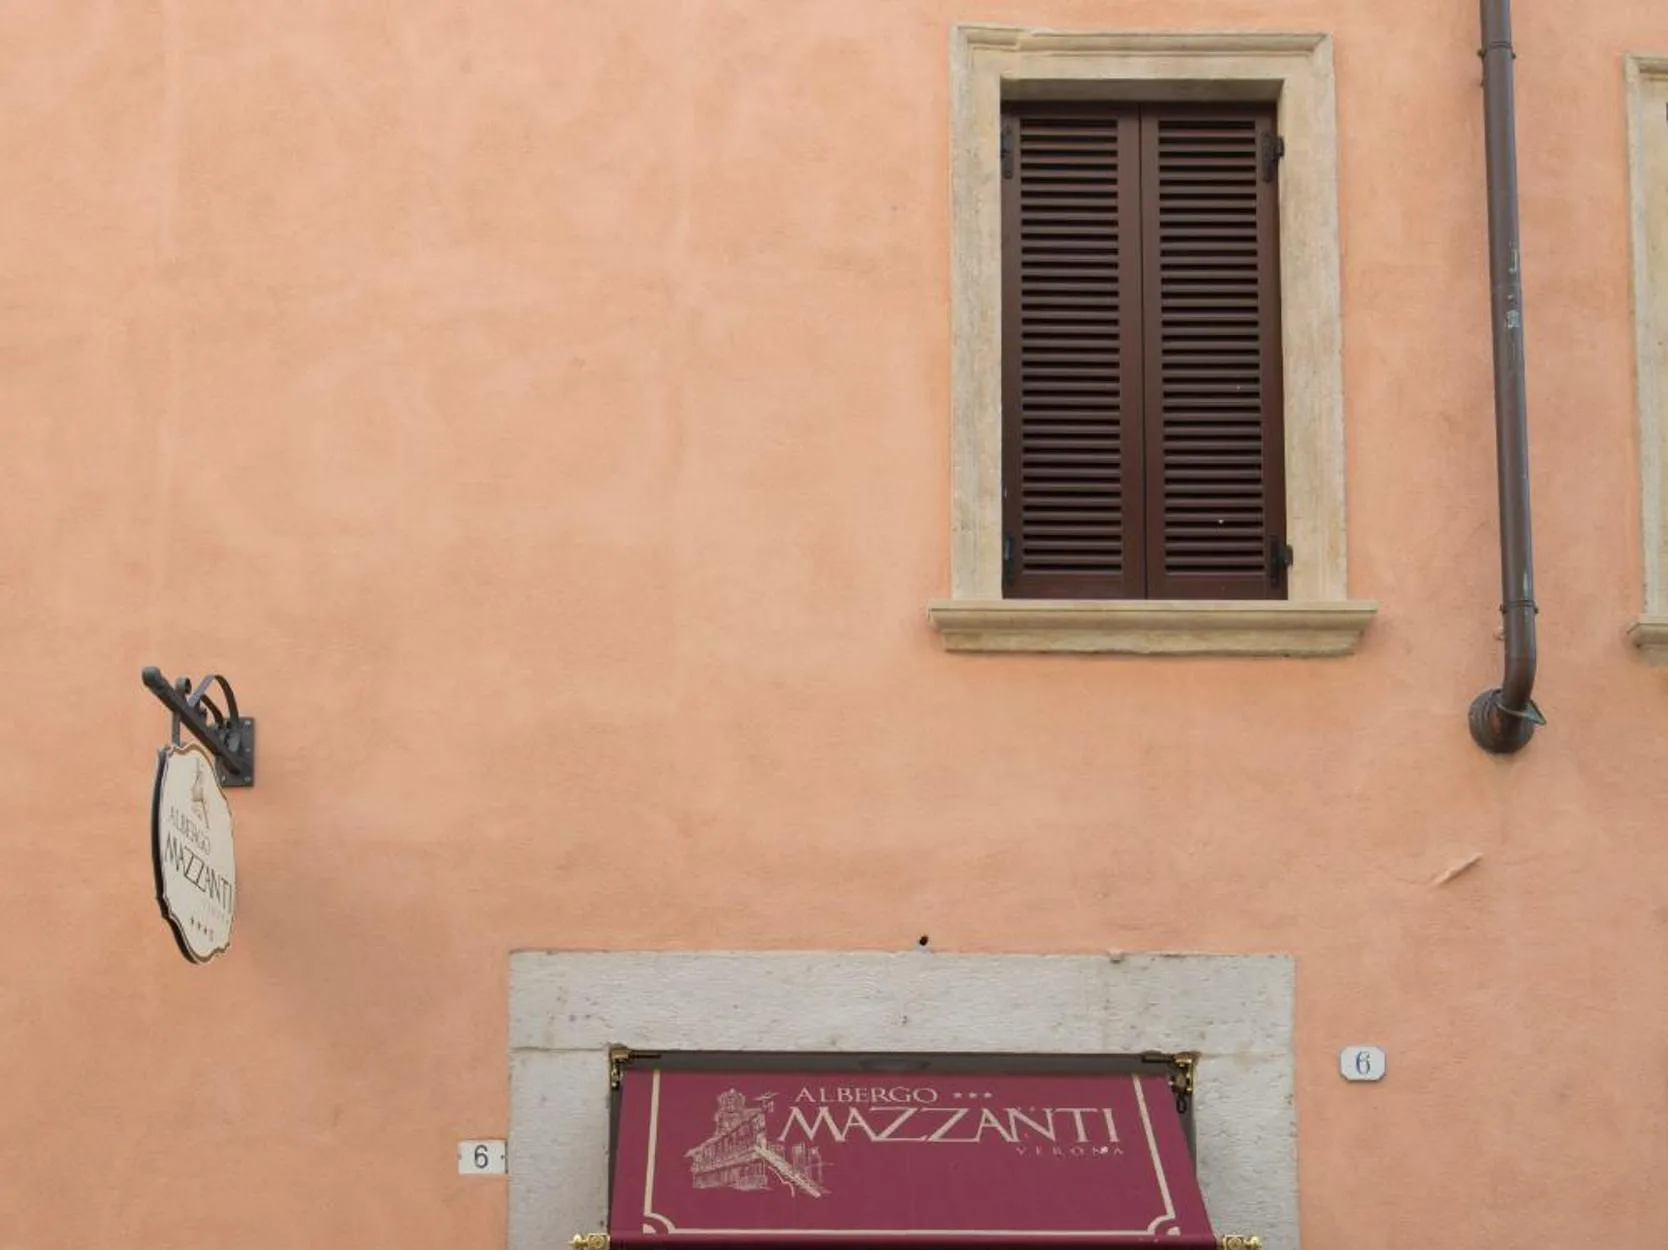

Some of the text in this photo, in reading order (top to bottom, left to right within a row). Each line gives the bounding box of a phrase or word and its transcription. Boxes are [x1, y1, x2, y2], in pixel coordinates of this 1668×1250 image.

[165, 832, 232, 914] MAZZANTI
[1356, 1051, 1371, 1075] 6
[795, 1086, 938, 1104] ALBERGO
[778, 1106, 1120, 1143] MAZZANTI
[474, 1144, 488, 1169] 6
